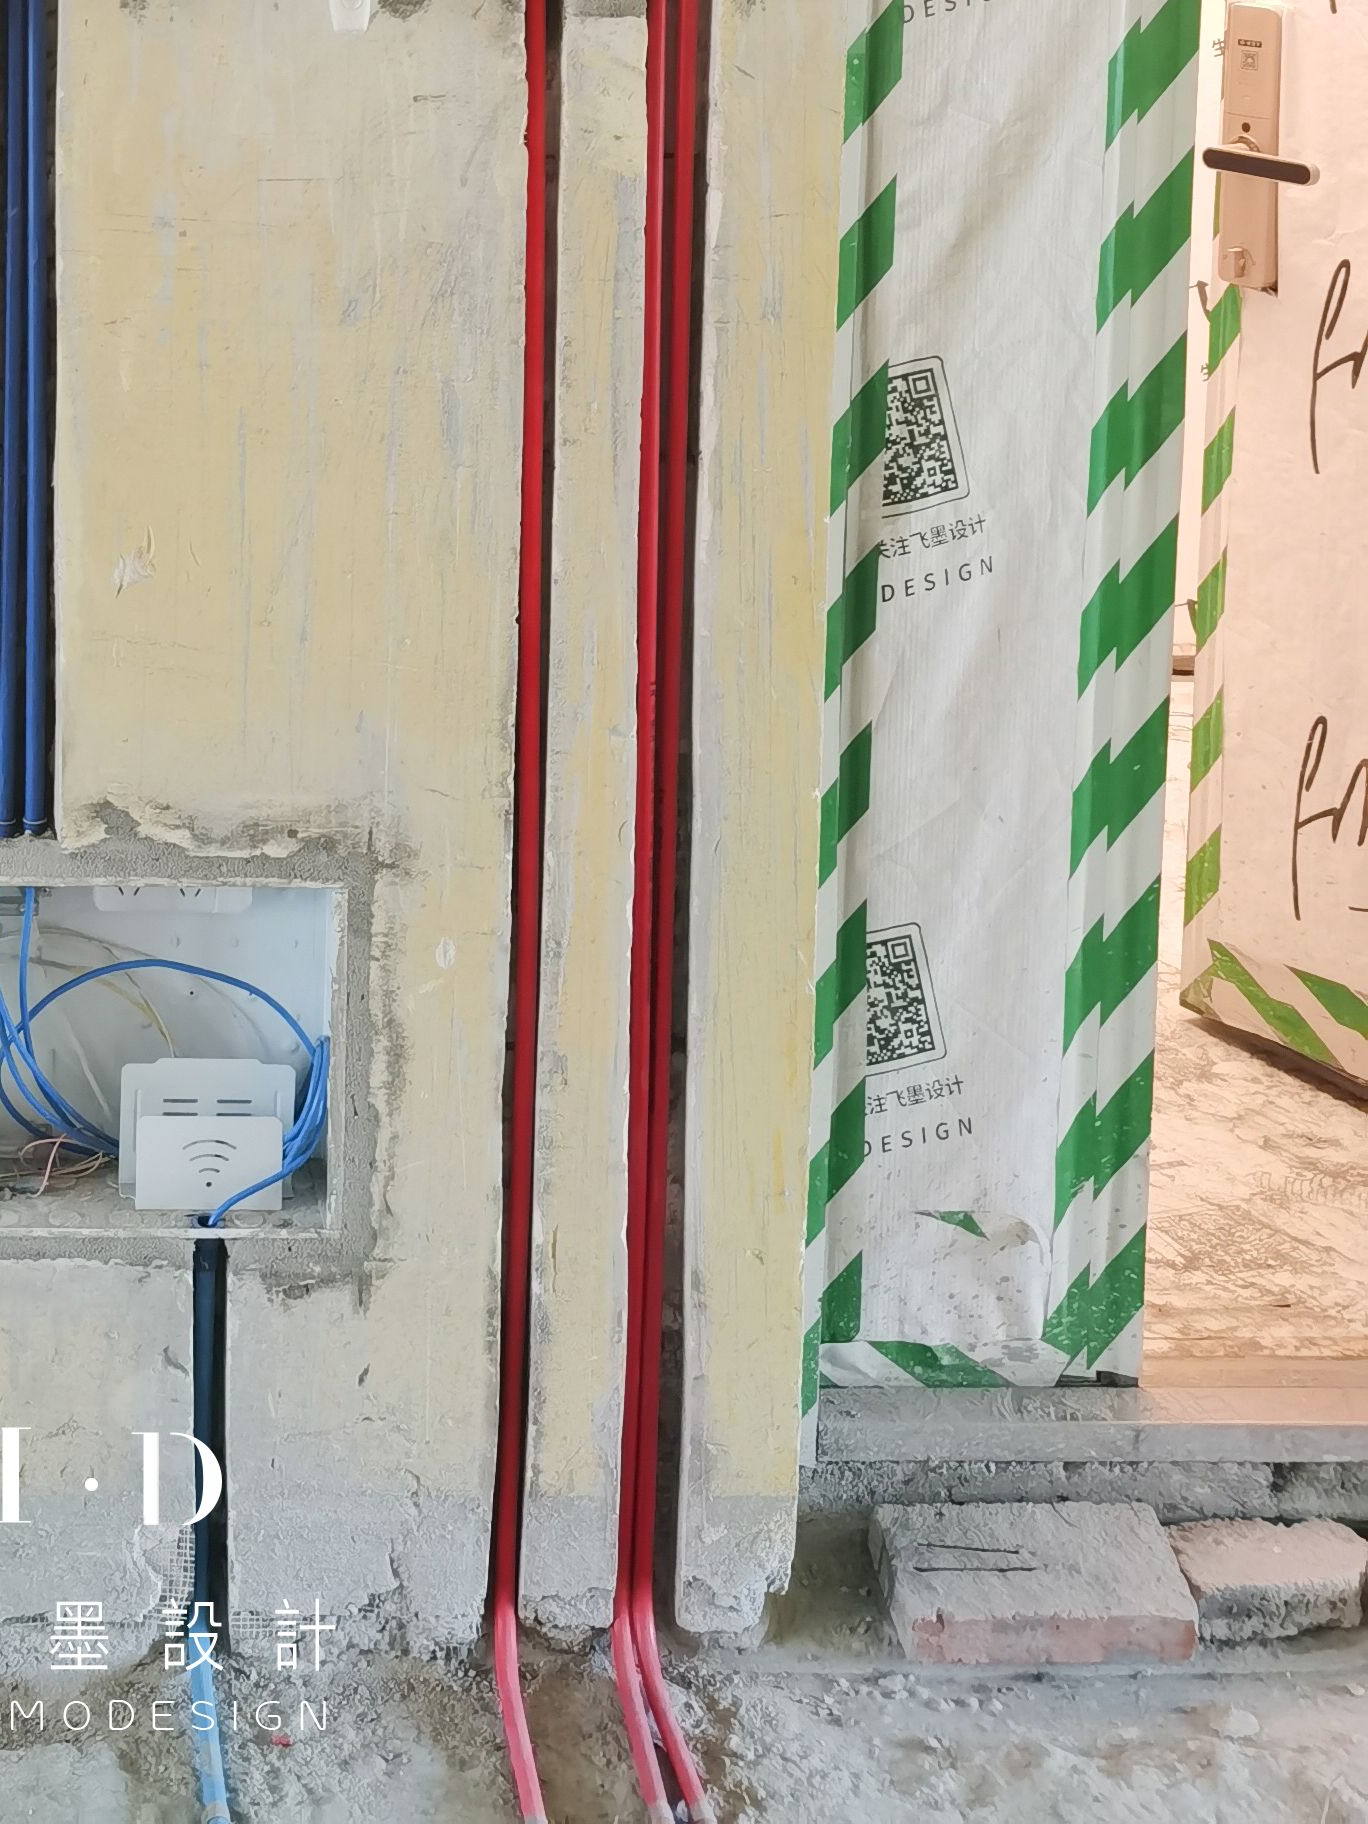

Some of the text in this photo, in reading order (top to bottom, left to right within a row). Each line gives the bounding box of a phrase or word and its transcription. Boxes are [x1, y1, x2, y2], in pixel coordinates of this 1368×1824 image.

[881, 556, 993, 603] DESIGN
[864, 1075, 964, 1116] 注飞墨设计
